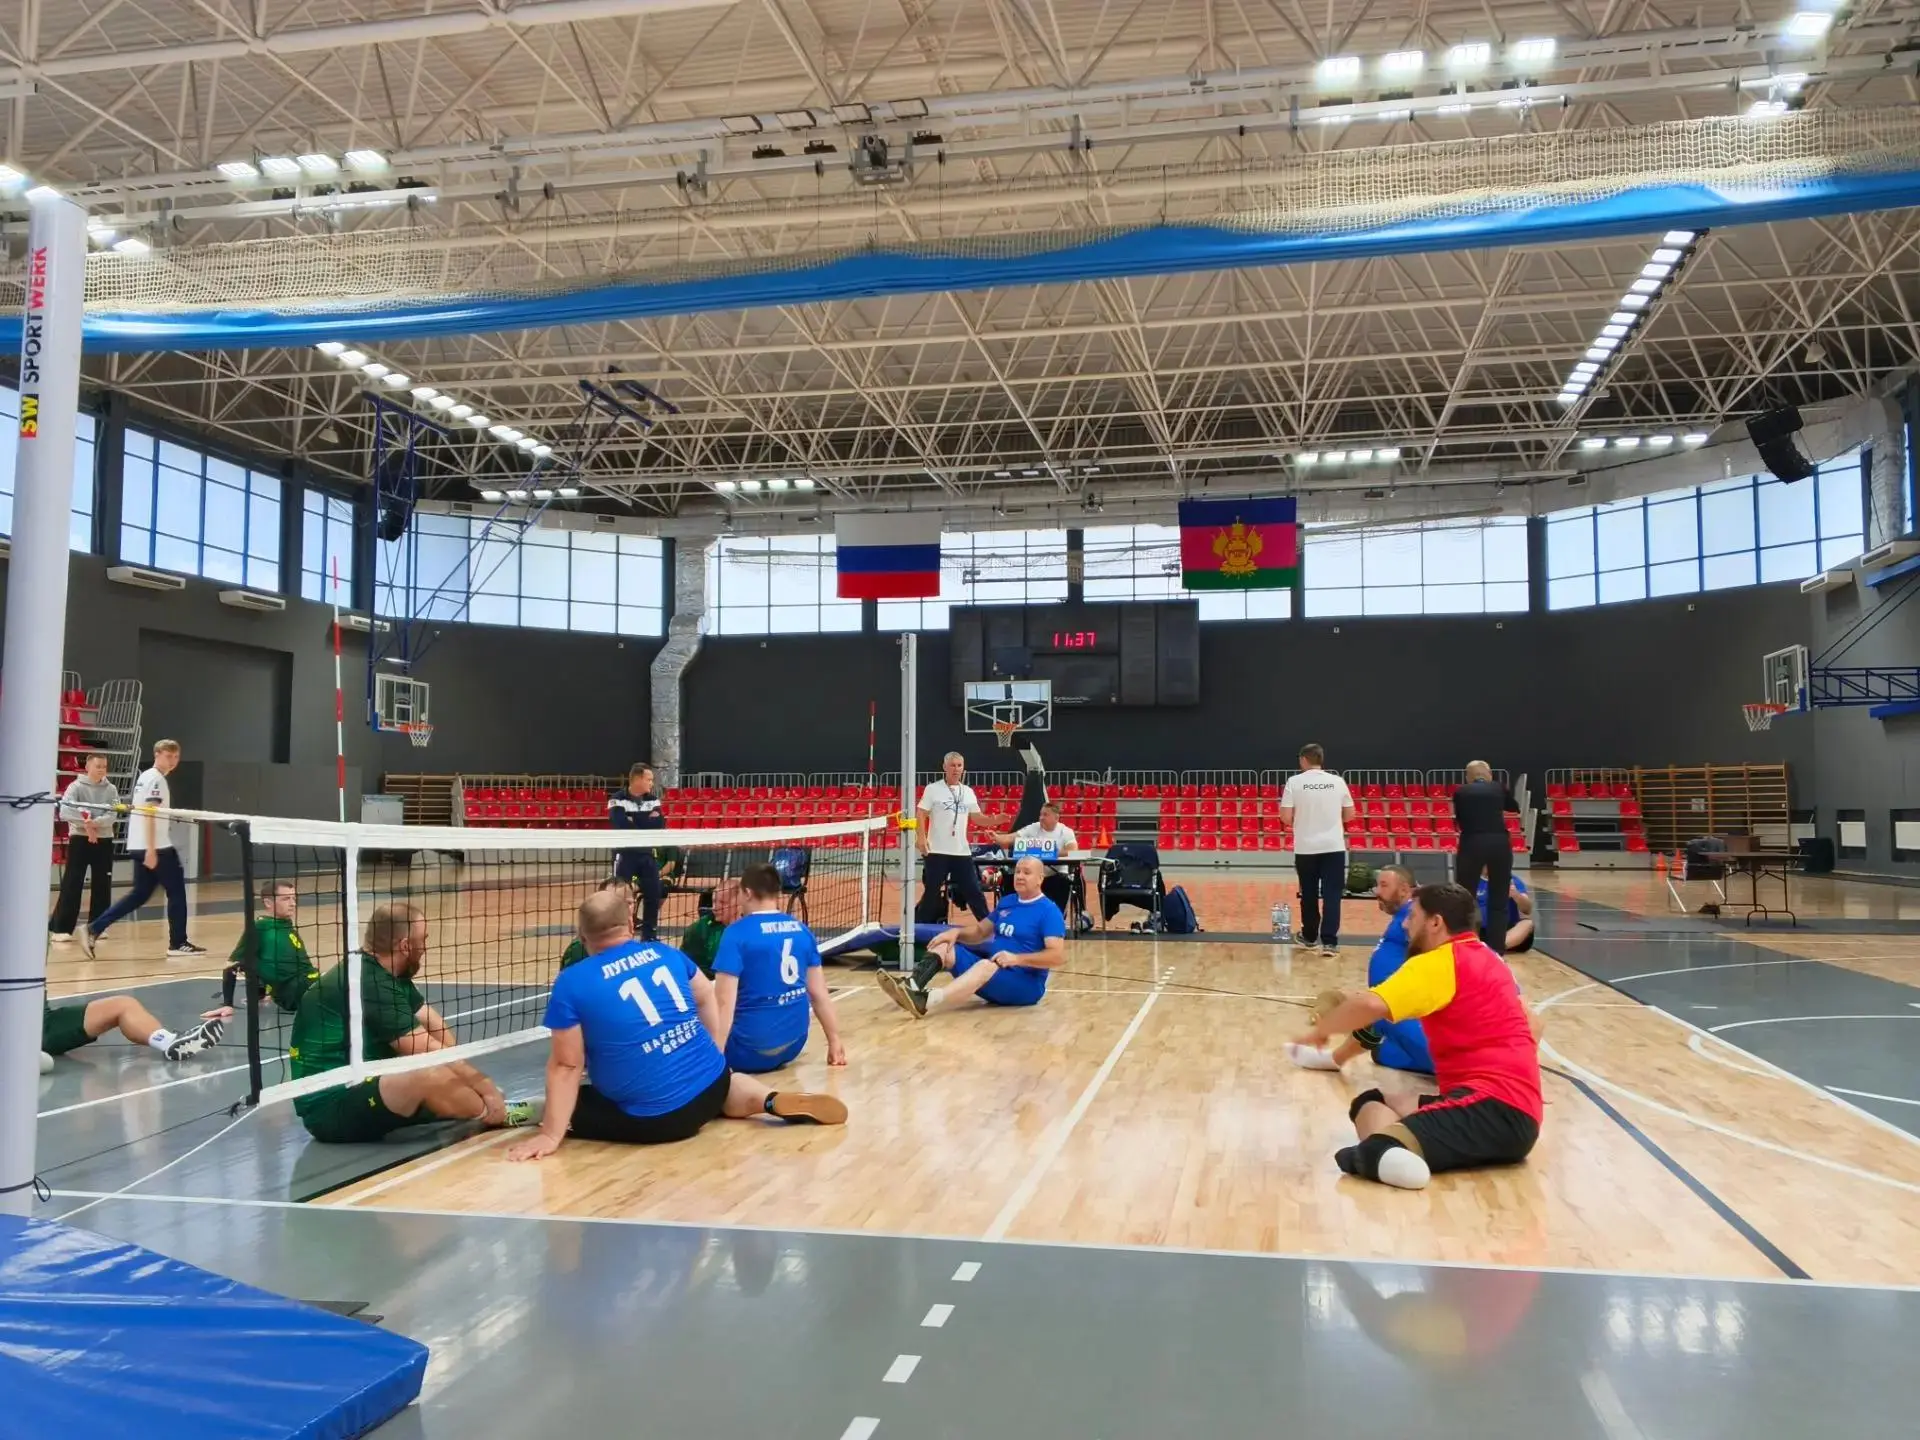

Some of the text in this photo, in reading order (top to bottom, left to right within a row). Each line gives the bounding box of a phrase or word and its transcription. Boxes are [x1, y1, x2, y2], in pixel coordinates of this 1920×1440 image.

[21, 394, 38, 434] SW
[601, 948, 661, 980] ЛУГАНСК
[780, 938, 799, 985] 6
[619, 965, 690, 1027] 11
